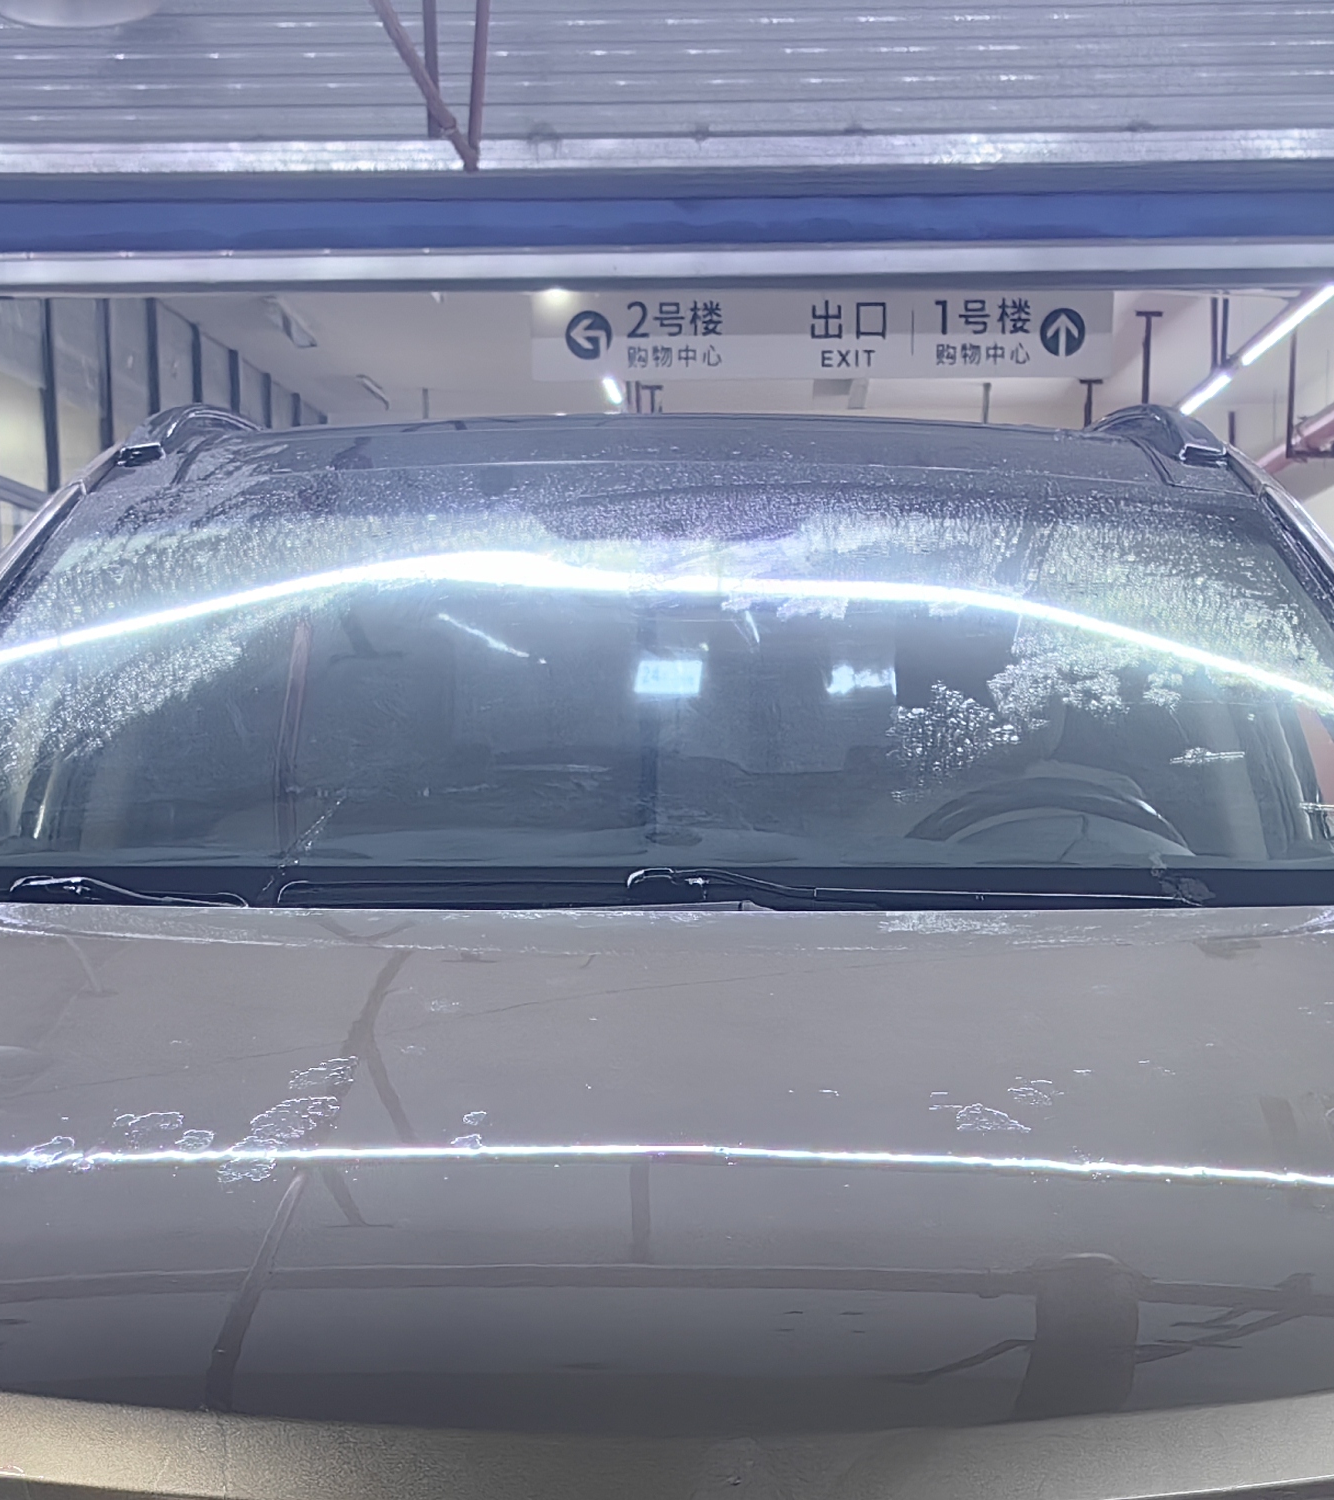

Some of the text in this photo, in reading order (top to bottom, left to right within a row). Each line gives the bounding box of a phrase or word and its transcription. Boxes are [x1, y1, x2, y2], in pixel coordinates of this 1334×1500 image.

[626, 299, 724, 339] 2号楼
[810, 299, 887, 341] 出口
[934, 297, 1031, 336] 1号楼
[626, 344, 723, 369] 购物中心
[820, 349, 876, 369] EXIT
[935, 341, 1030, 366] 购物中心
